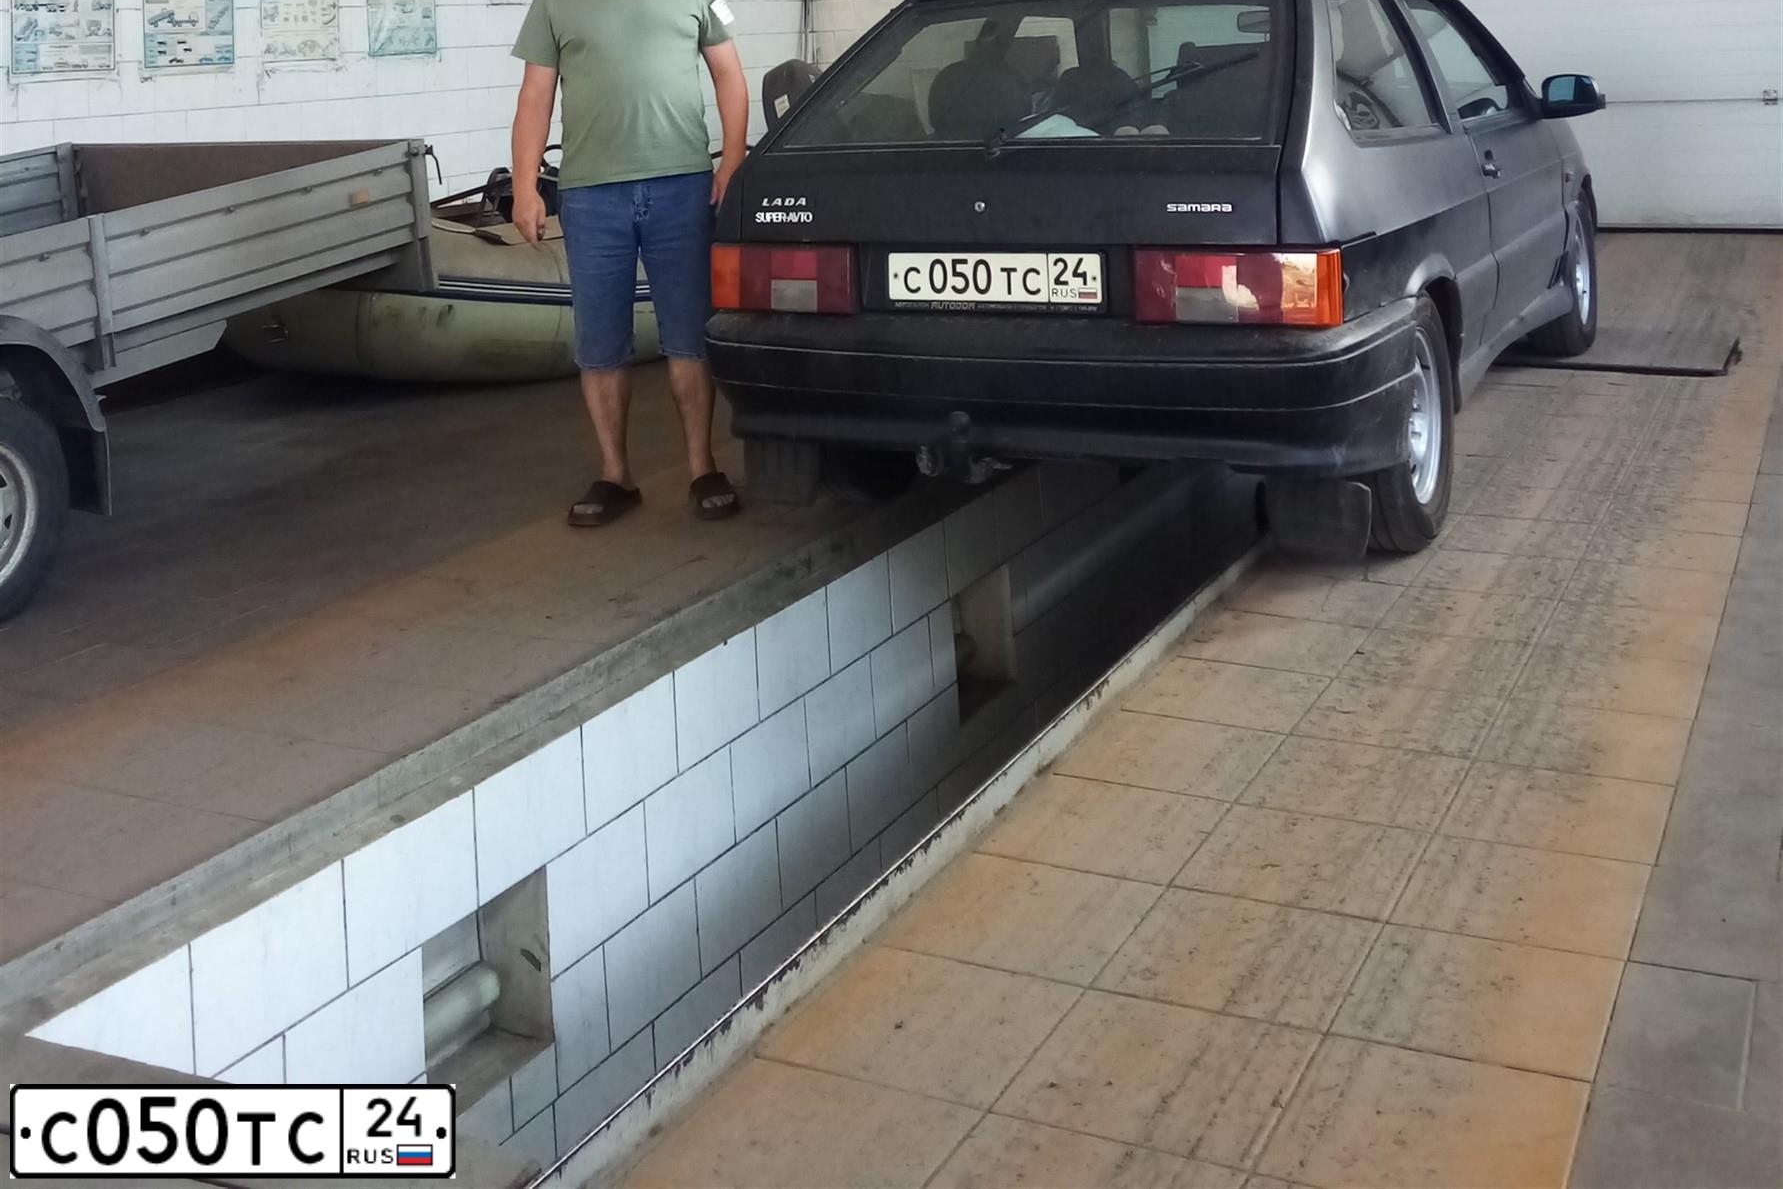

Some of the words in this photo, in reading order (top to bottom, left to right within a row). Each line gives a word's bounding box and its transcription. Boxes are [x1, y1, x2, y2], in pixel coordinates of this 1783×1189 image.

[762, 197, 806, 207] LADA
[1053, 257, 1088, 286] 24
[1052, 288, 1077, 299] RUS
